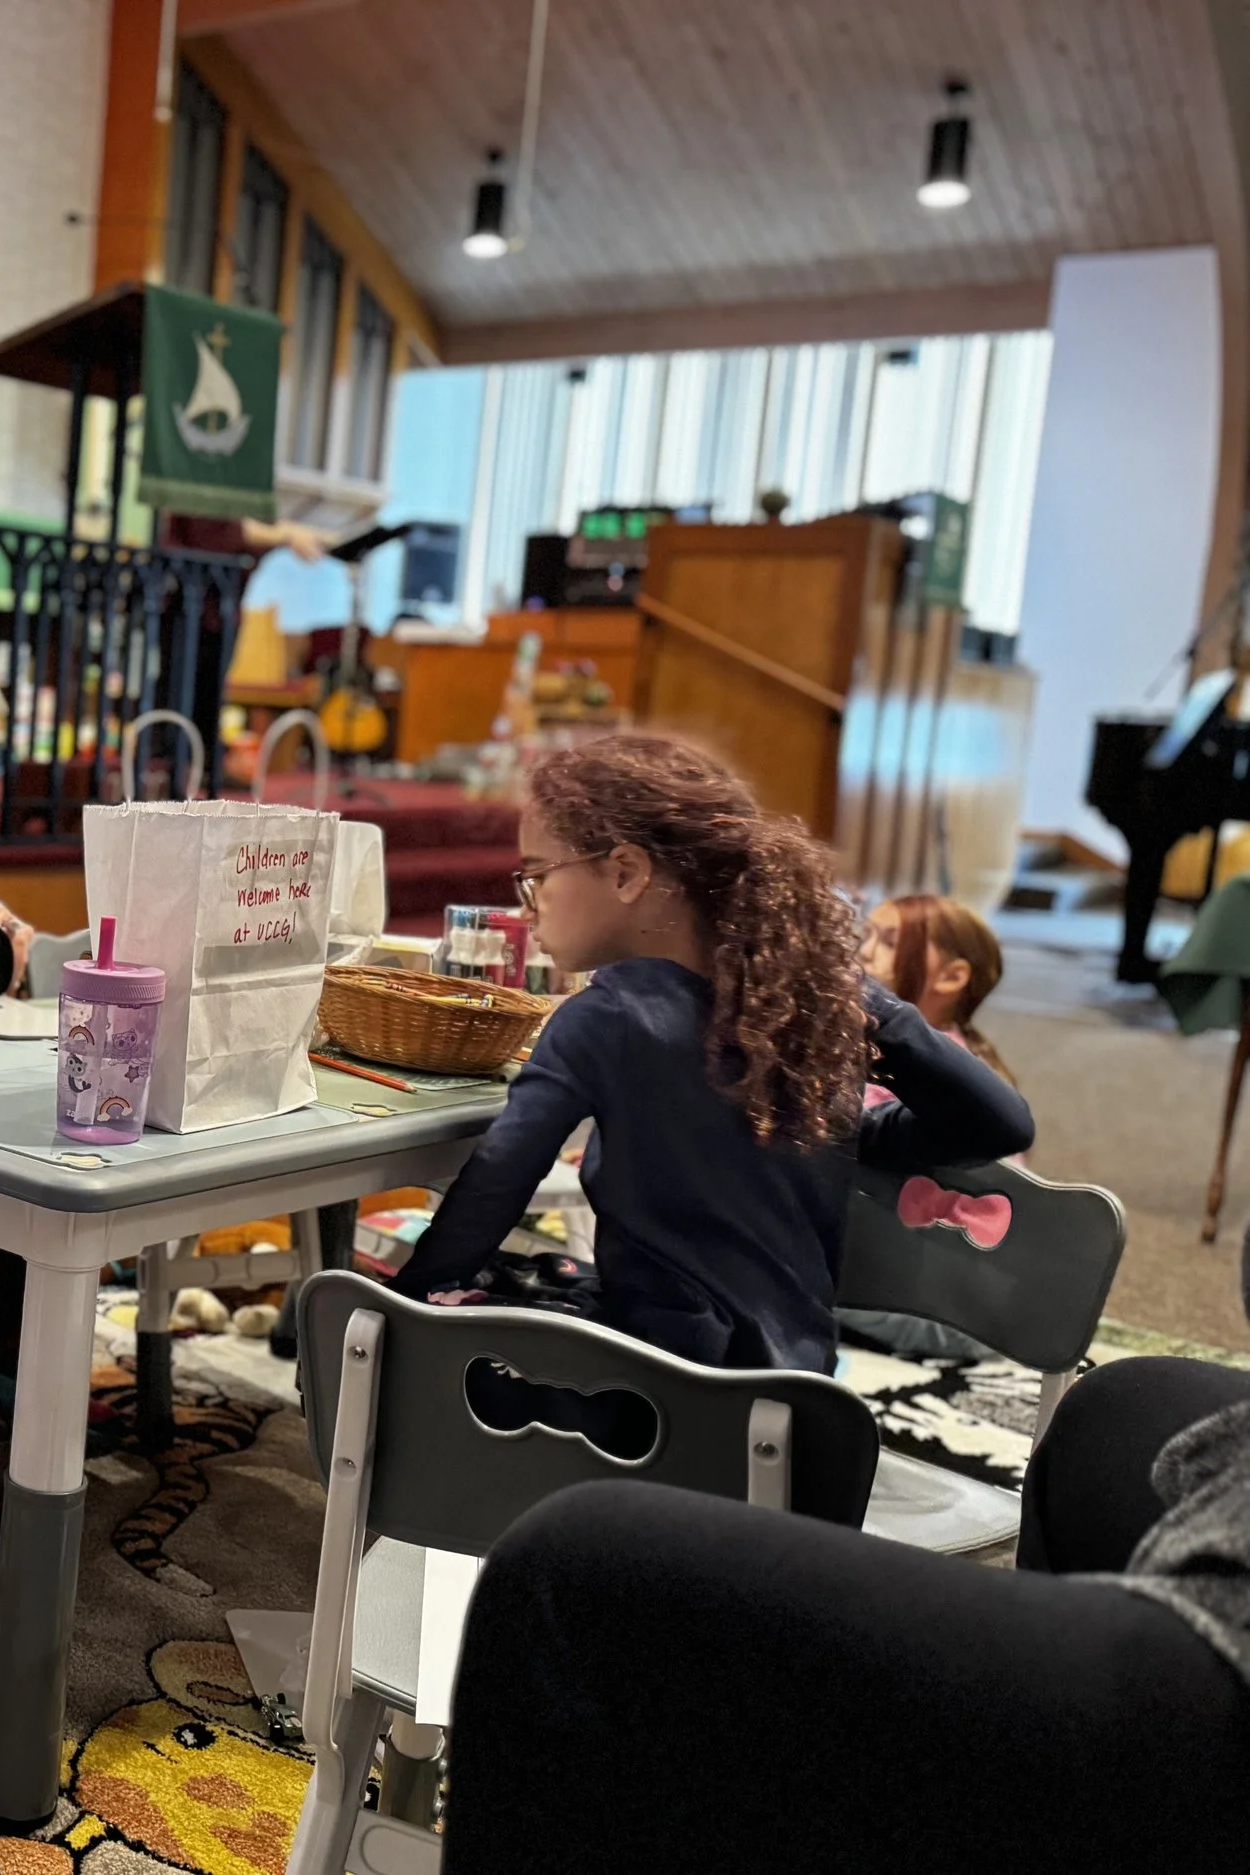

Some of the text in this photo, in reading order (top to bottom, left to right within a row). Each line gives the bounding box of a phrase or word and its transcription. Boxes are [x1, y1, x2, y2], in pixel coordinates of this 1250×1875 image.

[236, 844, 309, 874] Children are
[233, 911, 297, 945] at UCCG!
